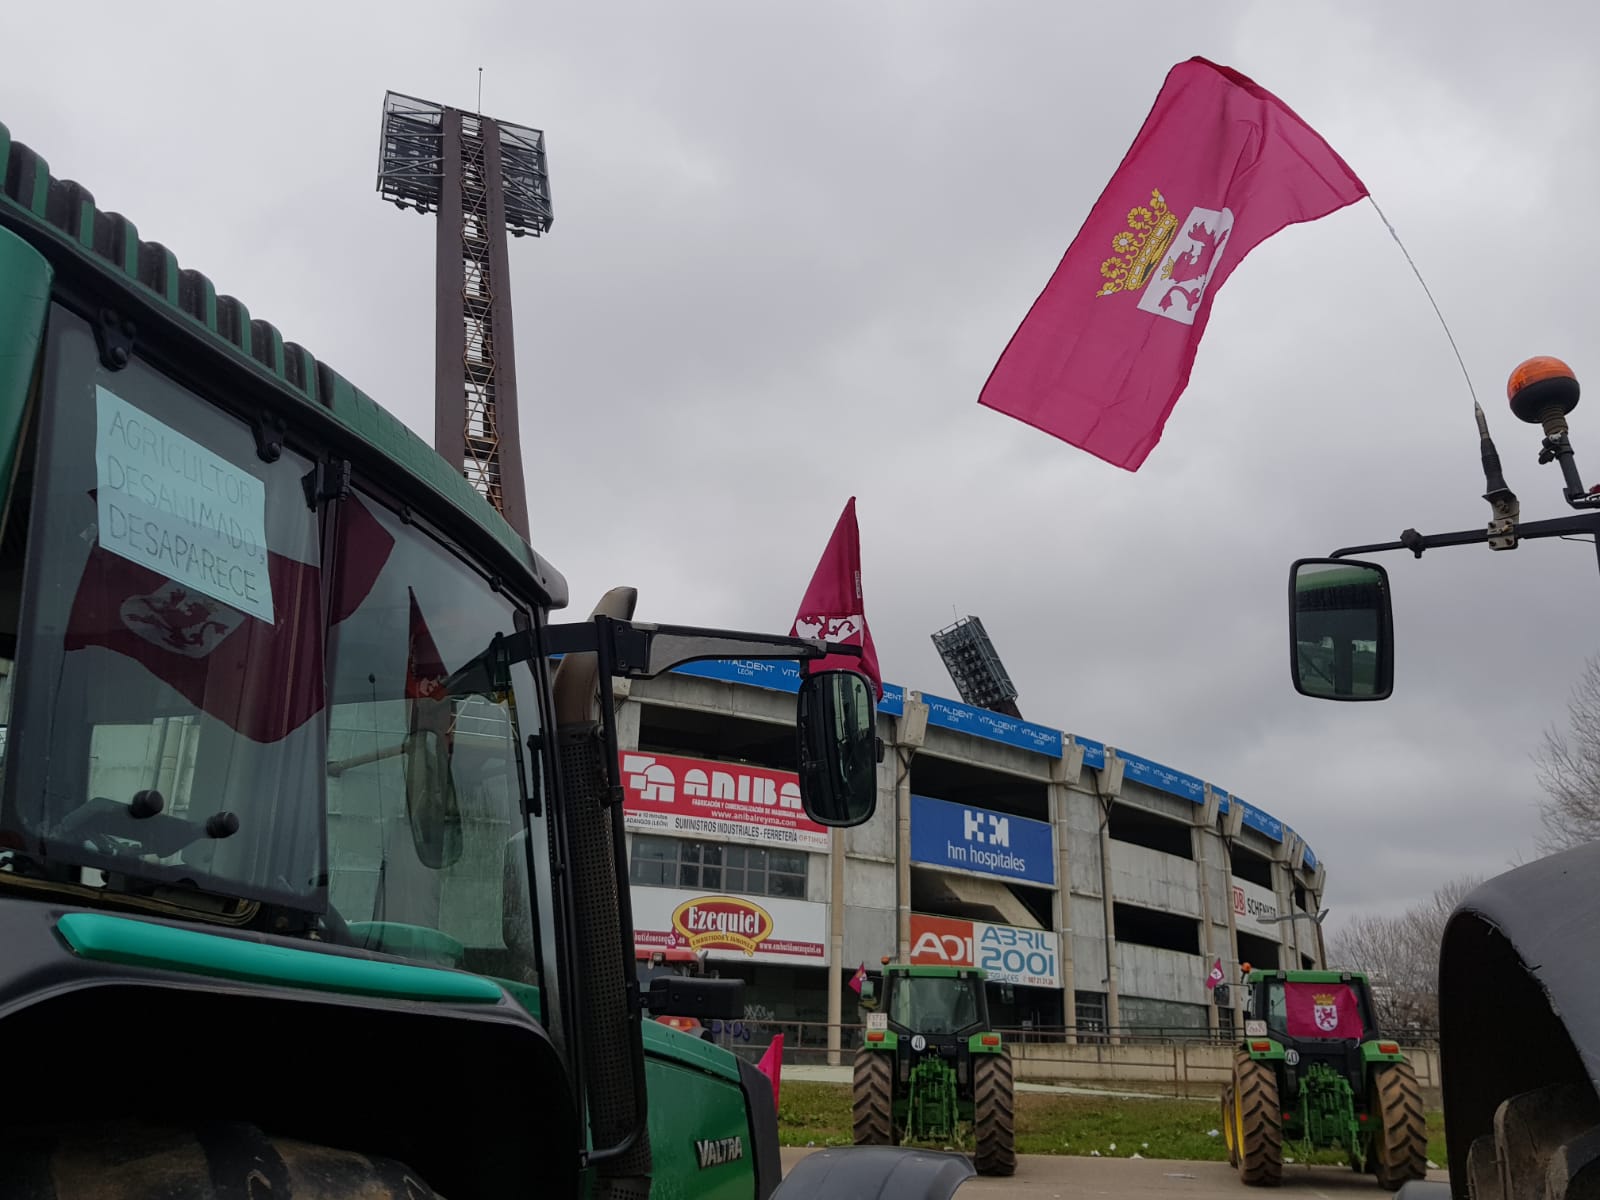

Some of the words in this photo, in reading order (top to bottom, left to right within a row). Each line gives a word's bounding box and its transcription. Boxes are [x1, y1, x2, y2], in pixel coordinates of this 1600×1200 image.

[109, 411, 252, 505] AGRICULTOR
[109, 504, 260, 604] DESAPARECE
[930, 703, 975, 720] VITALDENT
[978, 715, 1018, 733] VITALDENT
[1021, 727, 1057, 744] VITALDENT
[683, 768, 803, 810] ANIBA
[675, 817, 717, 833] SUMINISTROS
[717, 822, 759, 839] INDUSTRIALES
[711, 810, 797, 825] www.anibalreyma.com
[947, 840, 967, 861] hm
[970, 844, 1026, 872] hospitales
[688, 906, 760, 935] Ezequiel
[980, 926, 1053, 951] ABRIL
[980, 946, 1054, 977] 2001
[915, 1036, 923, 1049] 40
[697, 1136, 743, 1168] VALTRA
